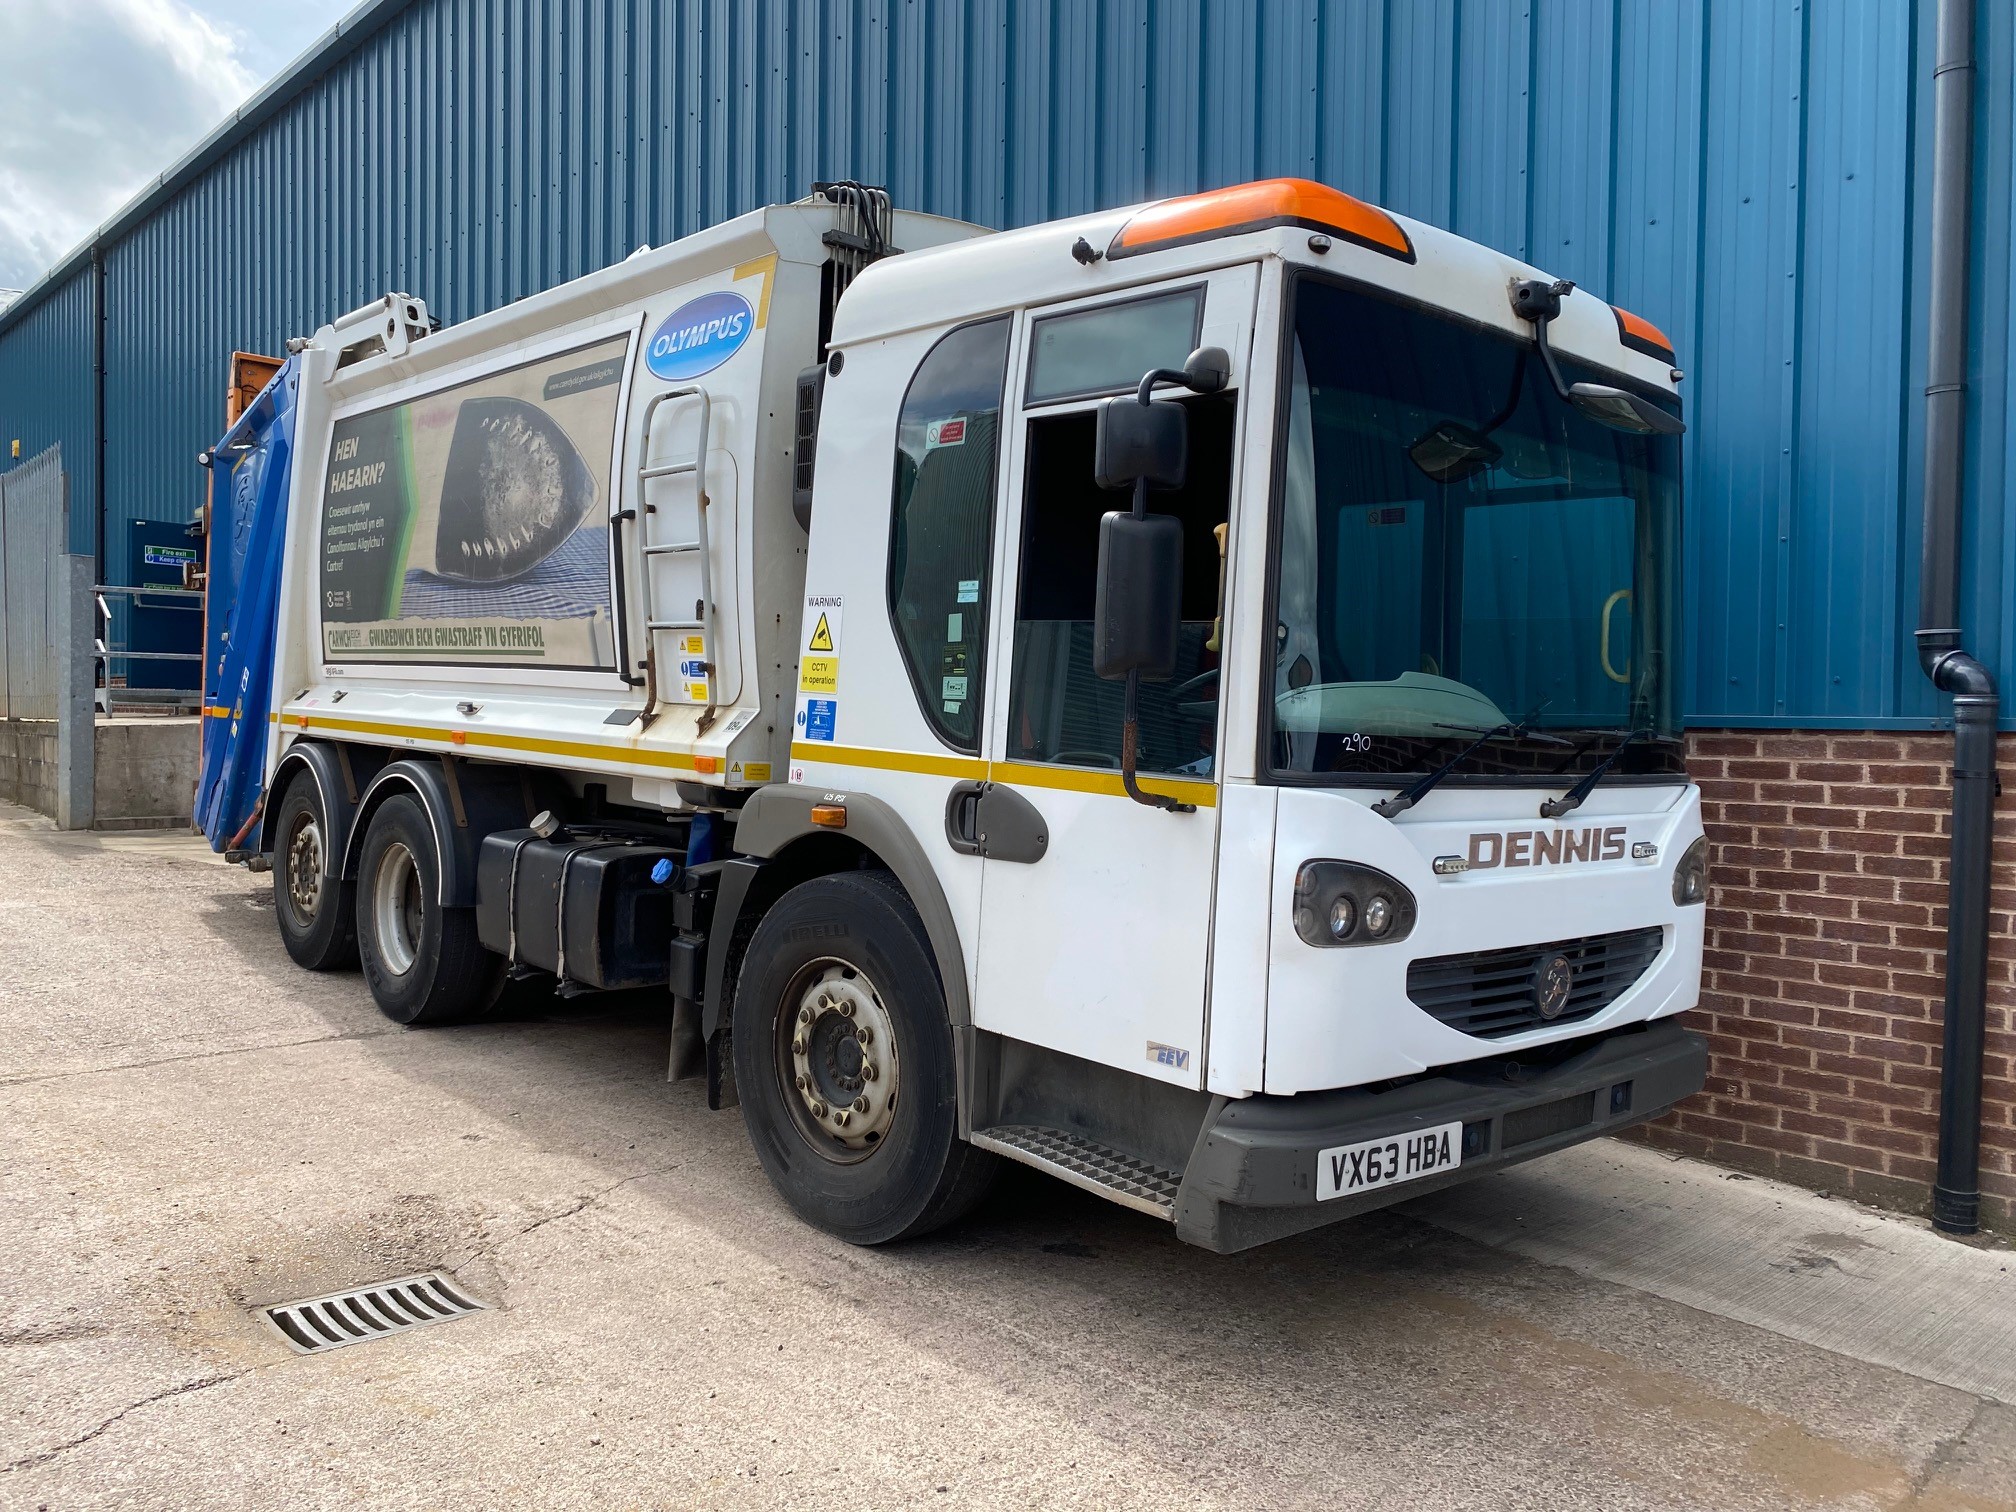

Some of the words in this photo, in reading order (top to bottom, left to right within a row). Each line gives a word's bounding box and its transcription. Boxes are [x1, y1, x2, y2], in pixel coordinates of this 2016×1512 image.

[653, 312, 746, 358] OLYMPUS
[335, 437, 360, 462] HEN
[331, 461, 386, 494] HAEARN?
[159, 556, 175, 564] Keep
[808, 597, 842, 607] WARNING
[369, 629, 414, 647] GWAREDWCH
[416, 628, 434, 647] EICH
[435, 627, 482, 647] GWASTRAFF
[484, 627, 498, 647] YN
[500, 626, 546, 648] GYFRIFOL
[811, 662, 828, 672] CCTV
[802, 676, 808, 684] in
[808, 675, 836, 686] operation
[1342, 732, 1371, 752] 290
[1468, 826, 1627, 870] DENNIS
[1157, 1046, 1188, 1068] EEV
[1331, 1142, 1400, 1191] VX63
[1406, 1131, 1451, 1174] HBA
